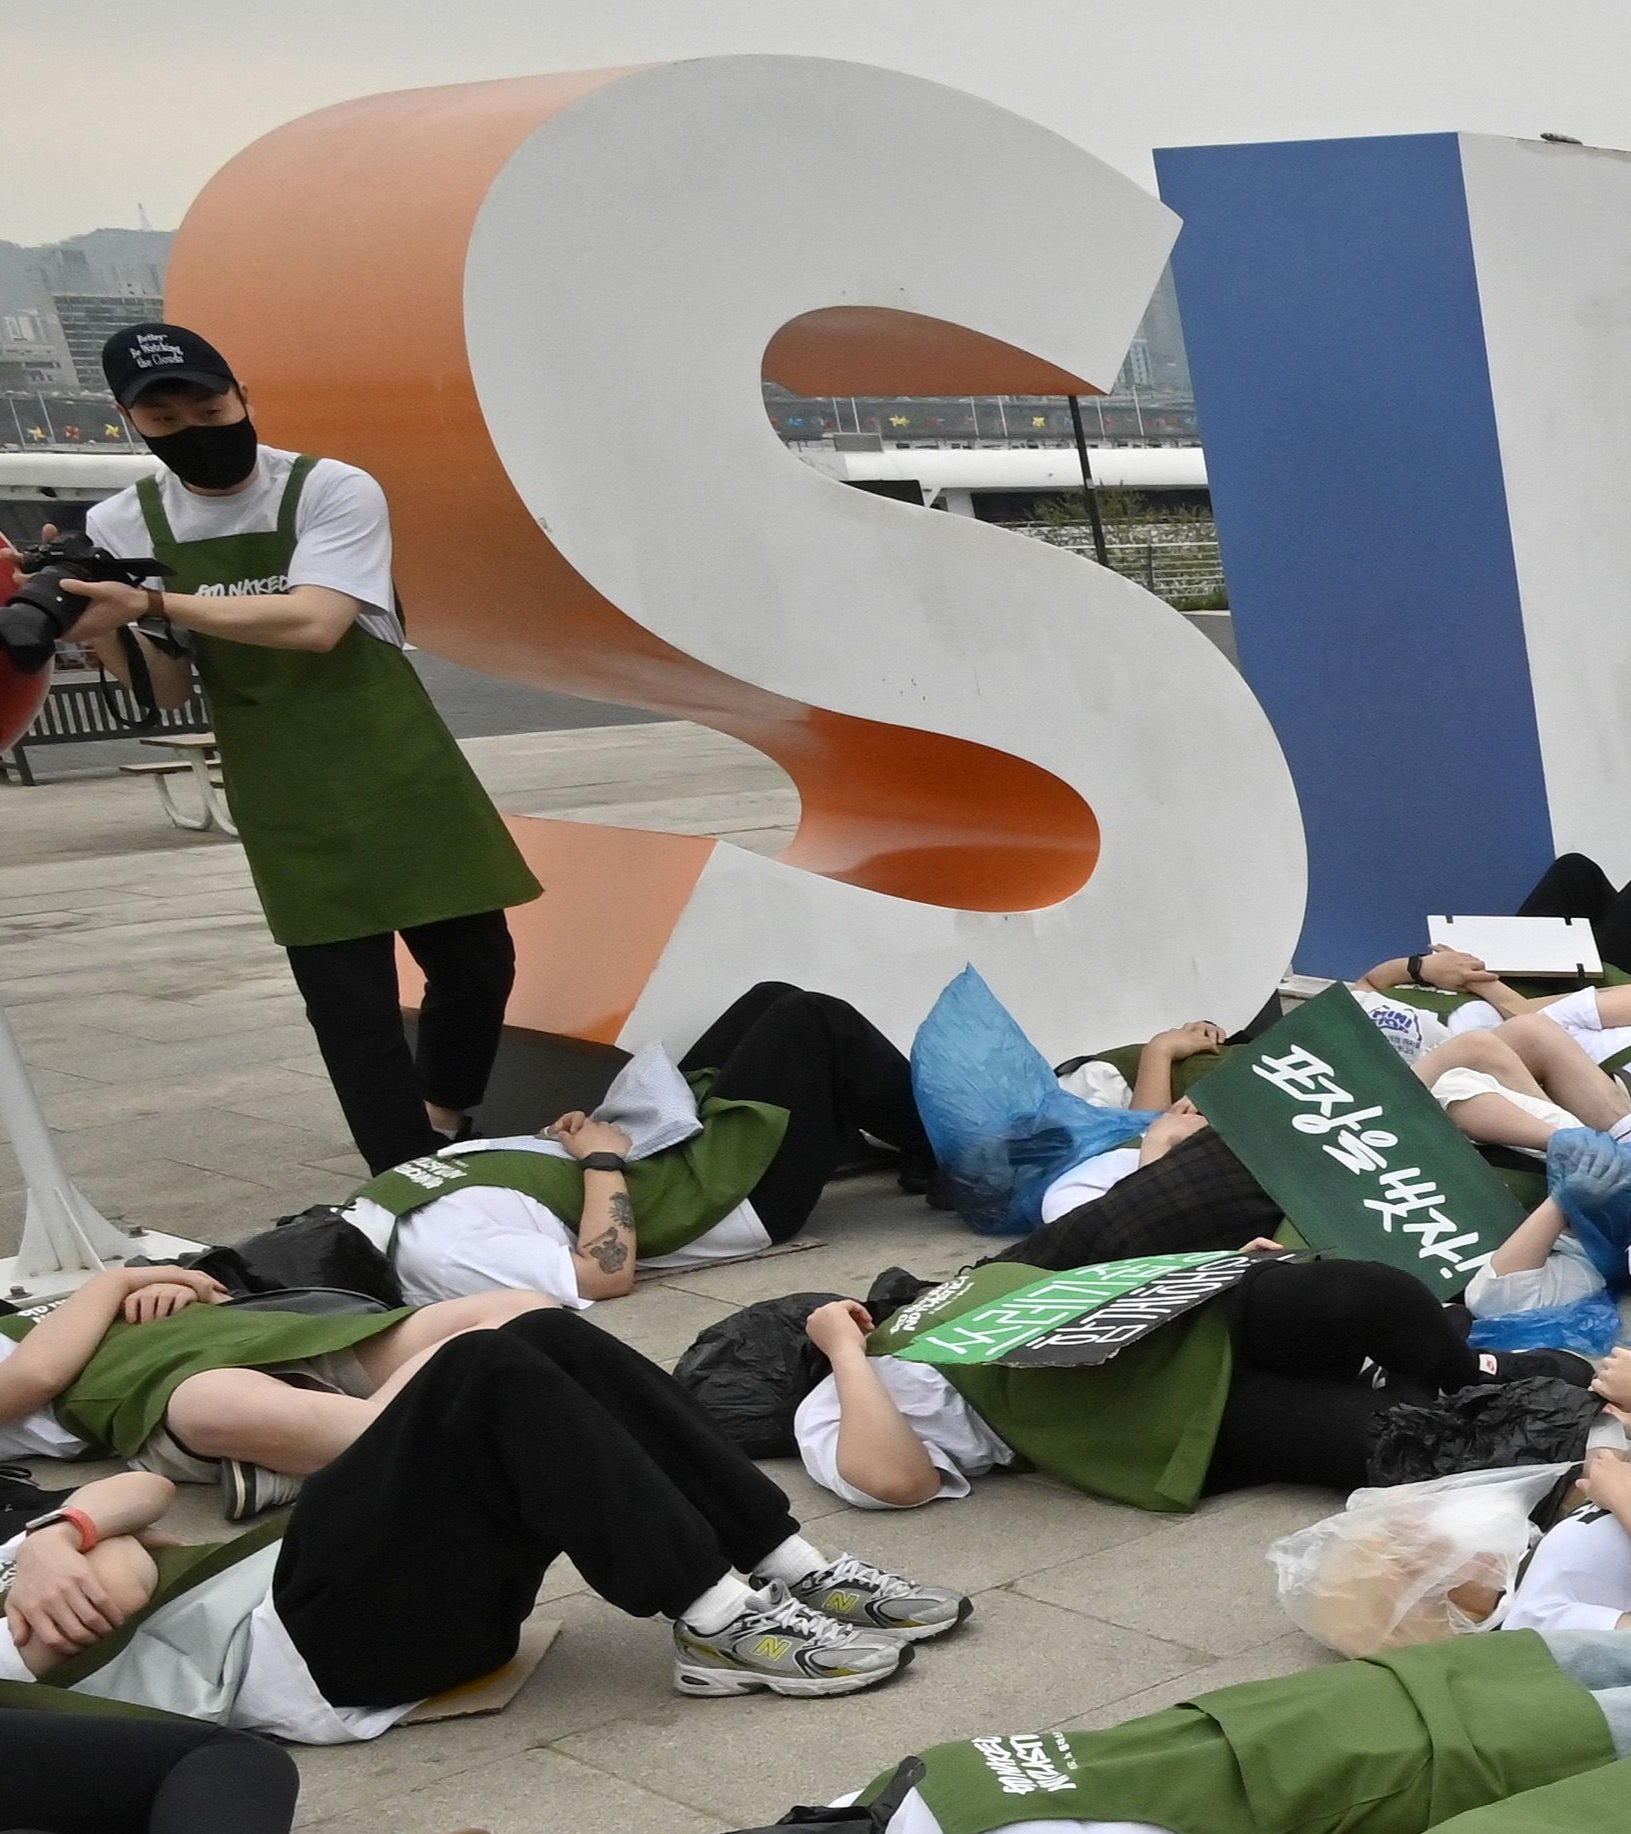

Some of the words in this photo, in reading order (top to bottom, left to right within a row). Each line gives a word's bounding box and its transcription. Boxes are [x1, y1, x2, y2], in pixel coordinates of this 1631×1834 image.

[1251, 1044, 1399, 1176] 포장을
[927, 1280, 1139, 1355] 쓰레기
[753, 1635, 789, 1660] N
